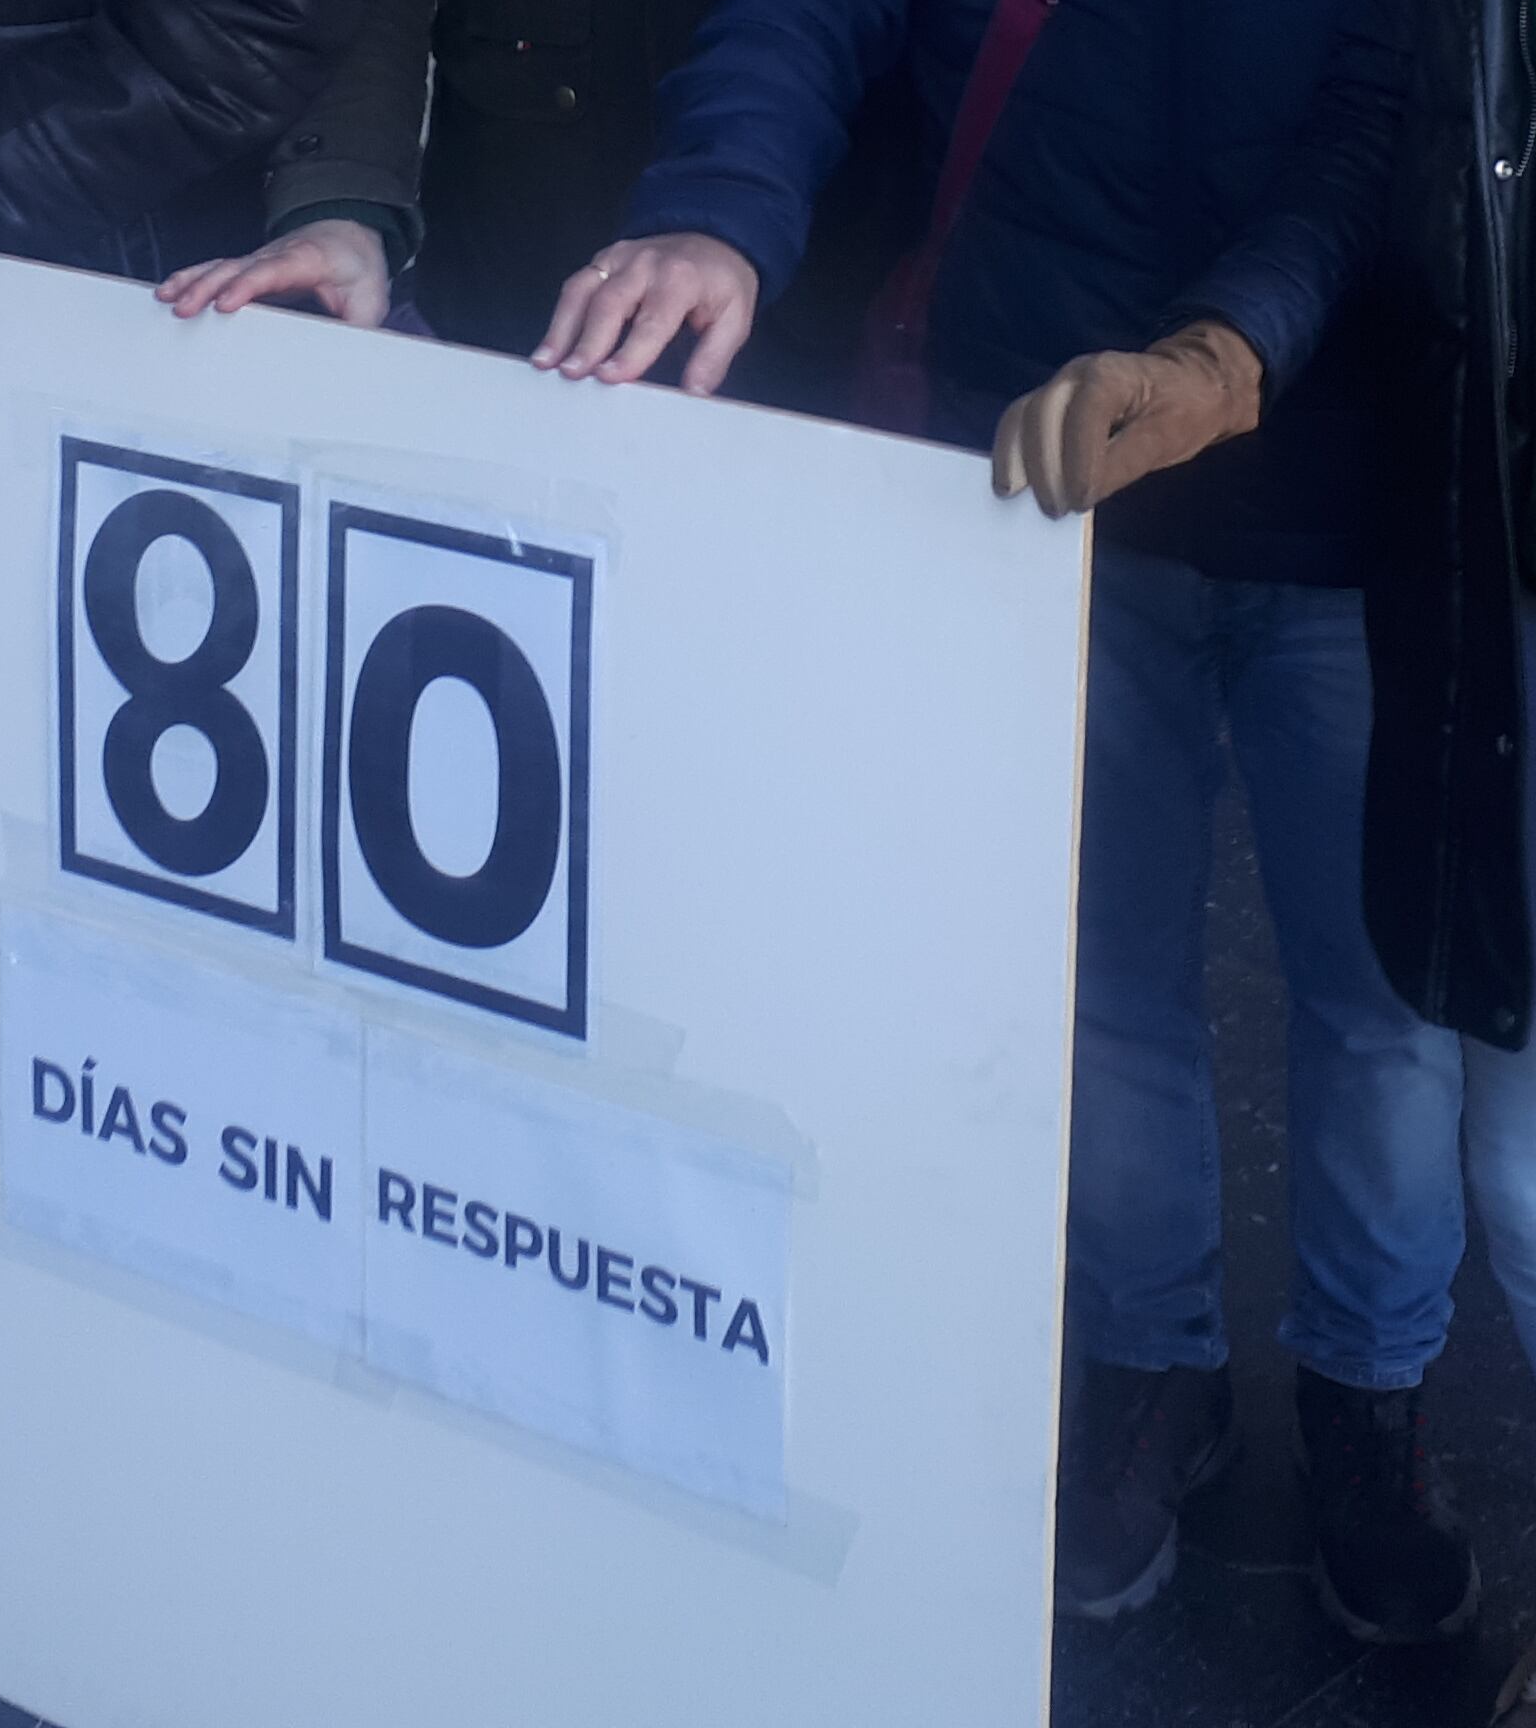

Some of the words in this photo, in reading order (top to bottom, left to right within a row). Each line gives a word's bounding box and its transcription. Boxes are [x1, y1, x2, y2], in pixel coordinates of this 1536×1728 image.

[31, 1055, 189, 1168] DÍAS
[217, 1125, 334, 1222] SIN
[376, 1168, 771, 1367] RESPUESTA
